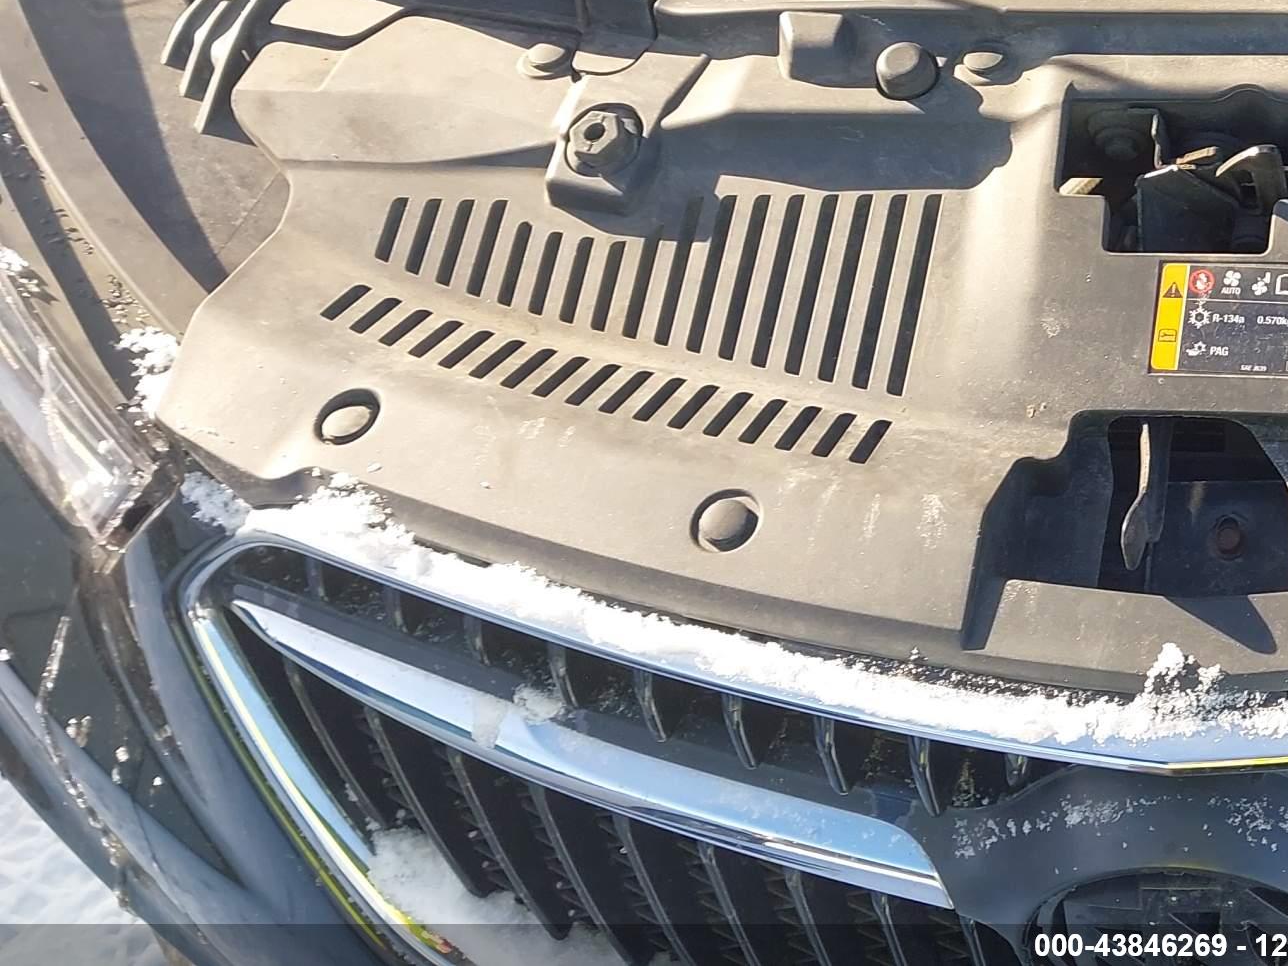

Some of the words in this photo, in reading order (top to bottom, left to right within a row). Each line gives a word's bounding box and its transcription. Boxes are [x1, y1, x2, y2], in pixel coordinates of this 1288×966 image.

[1221, 287, 1241, 295] AUTO
[1212, 314, 1245, 323] R-134a
[1209, 345, 1229, 357] PAG
